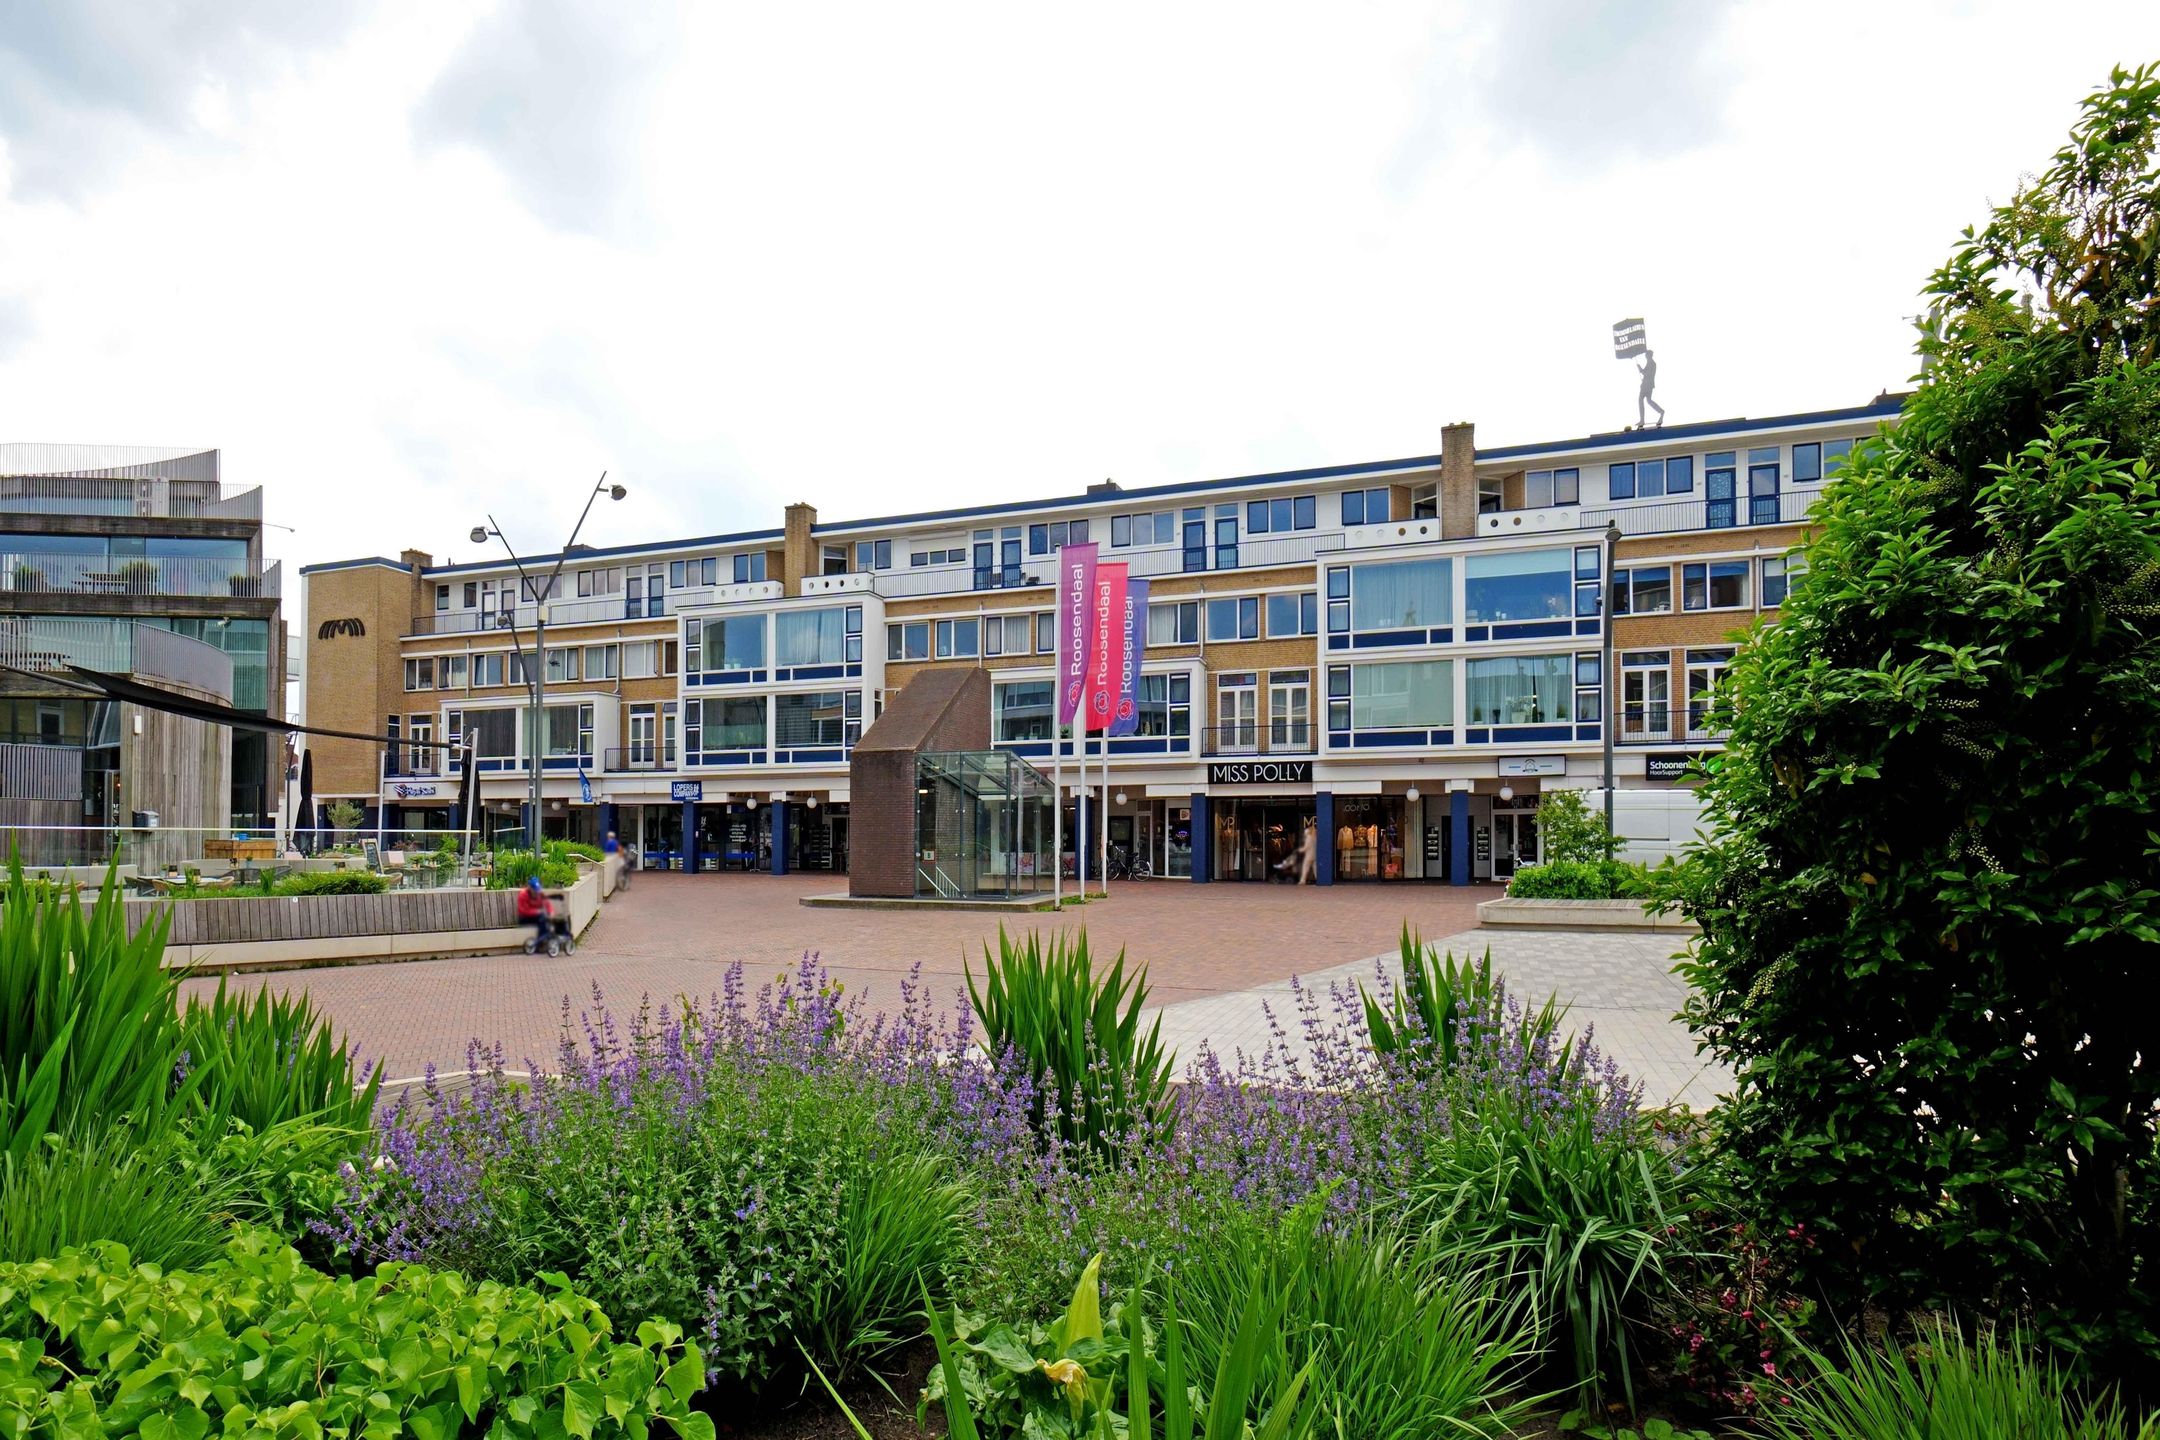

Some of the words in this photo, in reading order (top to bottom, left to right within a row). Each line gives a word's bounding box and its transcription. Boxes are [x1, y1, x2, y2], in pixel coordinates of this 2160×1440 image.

[1071, 563, 1083, 676] Roosendaal
[1097, 581, 1111, 685] Roosendaal
[1213, 765, 1249, 782] MISS
[1253, 763, 1305, 781] POLLY
[673, 783, 693, 791] LOPERS
[673, 790, 694, 798] COMPANY
